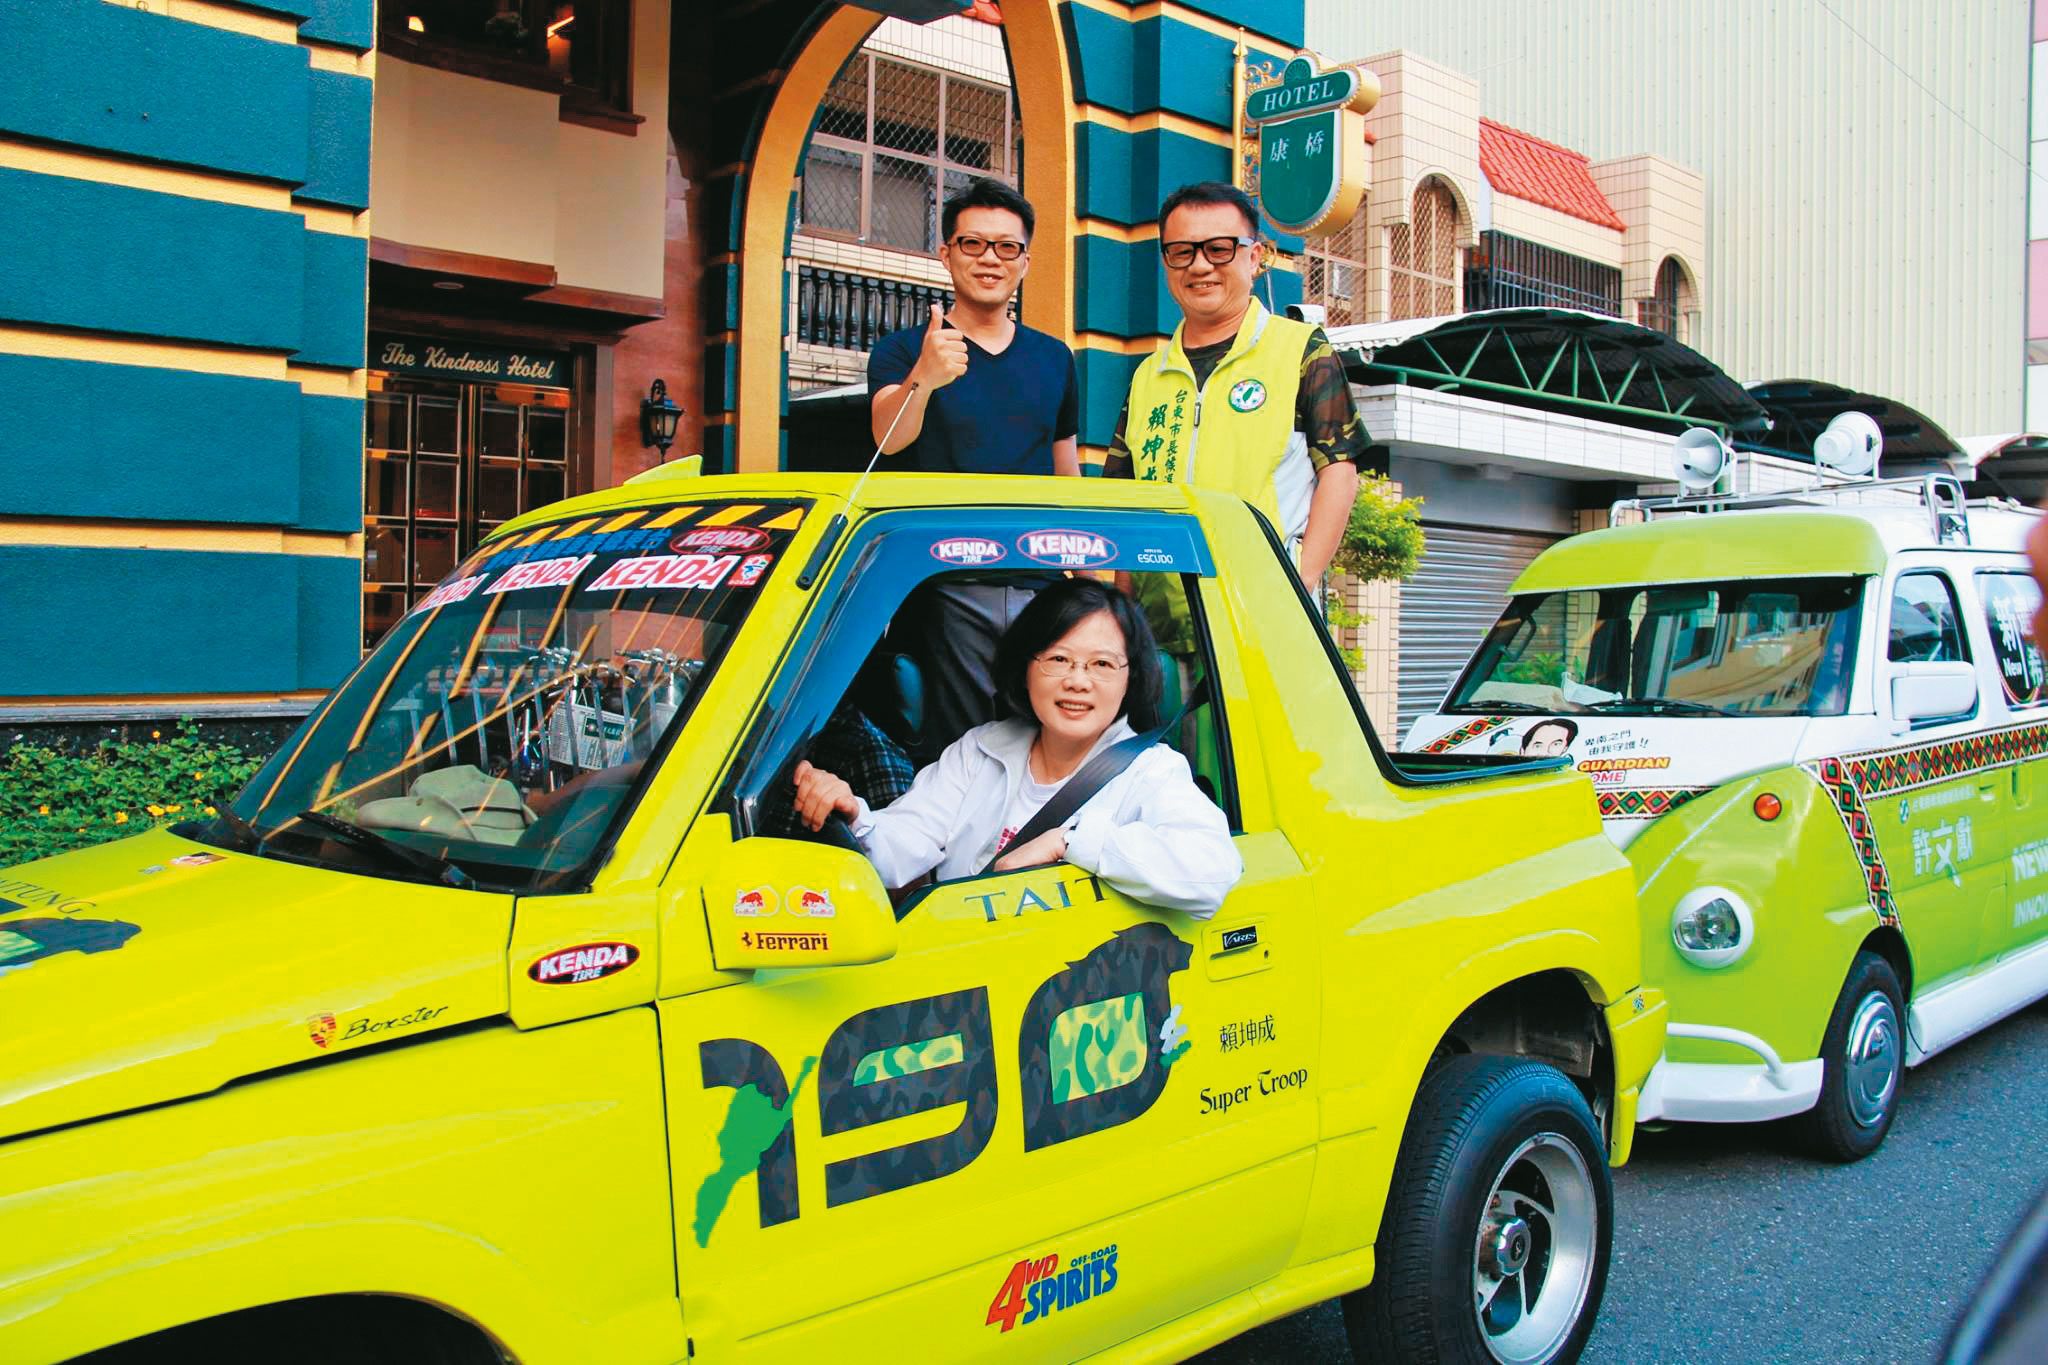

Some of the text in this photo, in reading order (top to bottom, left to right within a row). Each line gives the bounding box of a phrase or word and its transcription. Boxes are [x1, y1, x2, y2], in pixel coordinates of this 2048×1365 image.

[1263, 80, 1335, 112] HOTEL
[1269, 130, 1325, 163] 康橋
[382, 342, 554, 380] The Kindness Hotel
[677, 530, 761, 547] KENDA
[938, 542, 999, 558] KENDA
[1028, 534, 1109, 558] KENDA
[482, 554, 597, 595] KENDA
[585, 553, 741, 591] KENDA
[962, 554, 982, 564] TIRE
[1060, 554, 1086, 565] TIRE
[1137, 553, 1174, 565] ESCUDO
[1578, 757, 1670, 772] GUARDIAN
[755, 932, 829, 951] Ferrari
[539, 945, 629, 980] KENDA
[571, 967, 603, 983] TIRE
[340, 1006, 449, 1041] Boxster
[1219, 1014, 1276, 1053] 賴坤成
[1200, 1069, 1308, 1115] Super Troop
[1070, 1244, 1118, 1268] OFF-ROAD
[985, 1253, 1059, 1333] 4WD
[1022, 1252, 1119, 1325] SPIRITS
